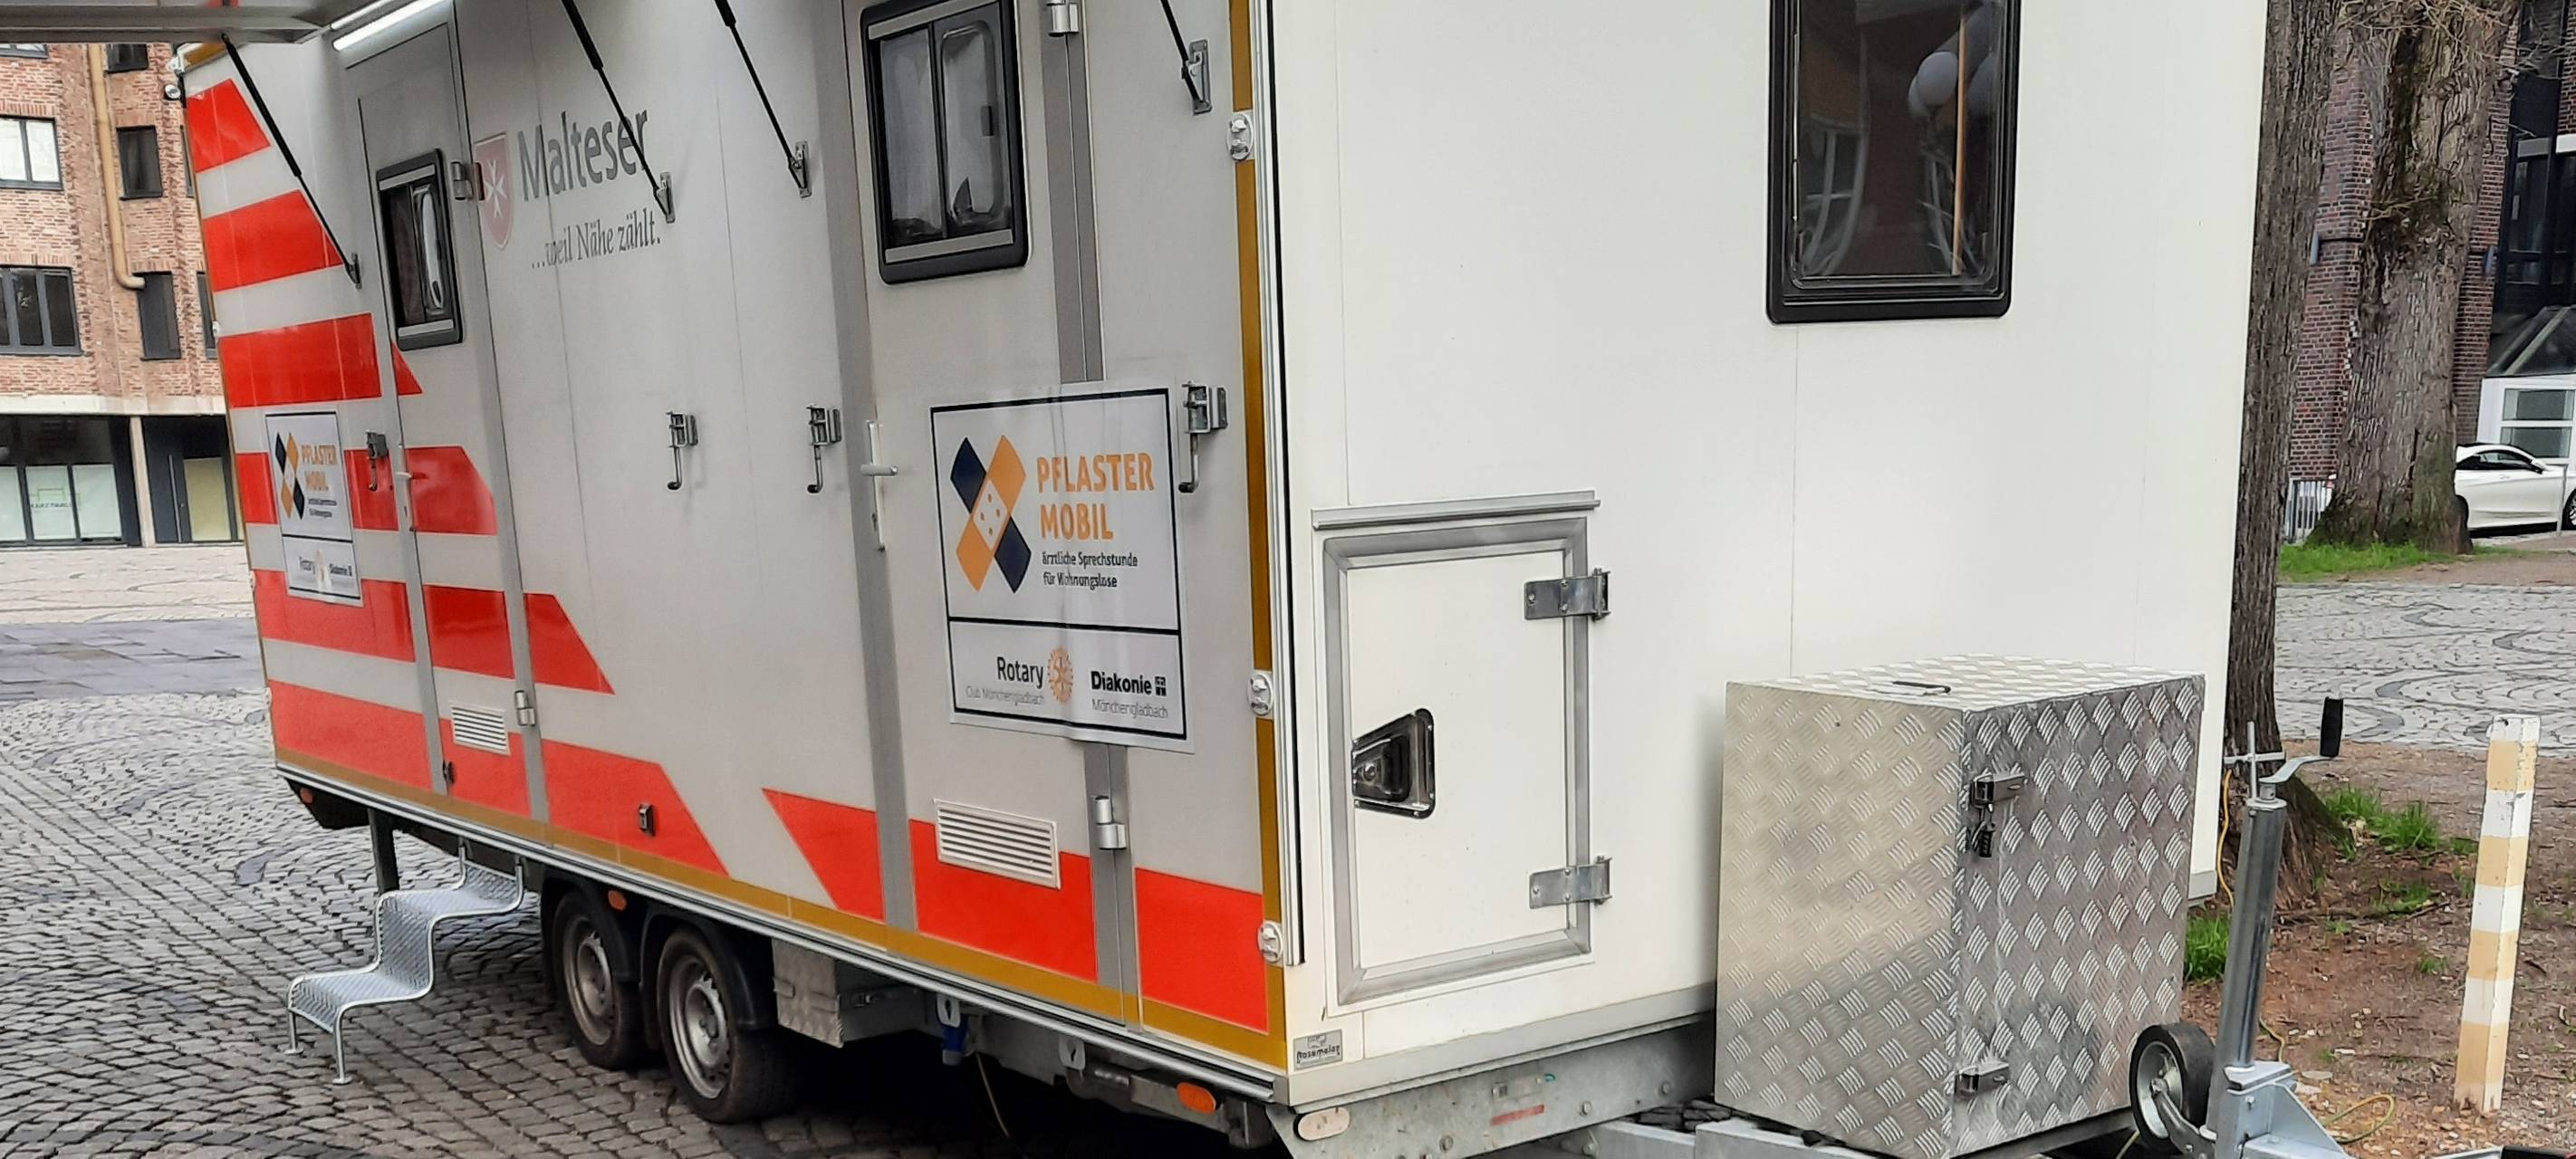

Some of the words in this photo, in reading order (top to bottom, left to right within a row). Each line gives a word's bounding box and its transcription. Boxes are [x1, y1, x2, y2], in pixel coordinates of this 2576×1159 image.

[517, 110, 648, 202] Malteser
[576, 218, 614, 261] Nähe
[618, 207, 660, 252] zählt.
[1037, 453, 1155, 493] PFLASTER
[1040, 503, 1114, 541] MOBIL
[1078, 551, 1139, 570] Sprechstunde
[1043, 571, 1055, 586] für
[1057, 571, 1118, 590] Wohnungslose
[996, 656, 1043, 688] Rotary
[1091, 671, 1152, 694] Diakonie
